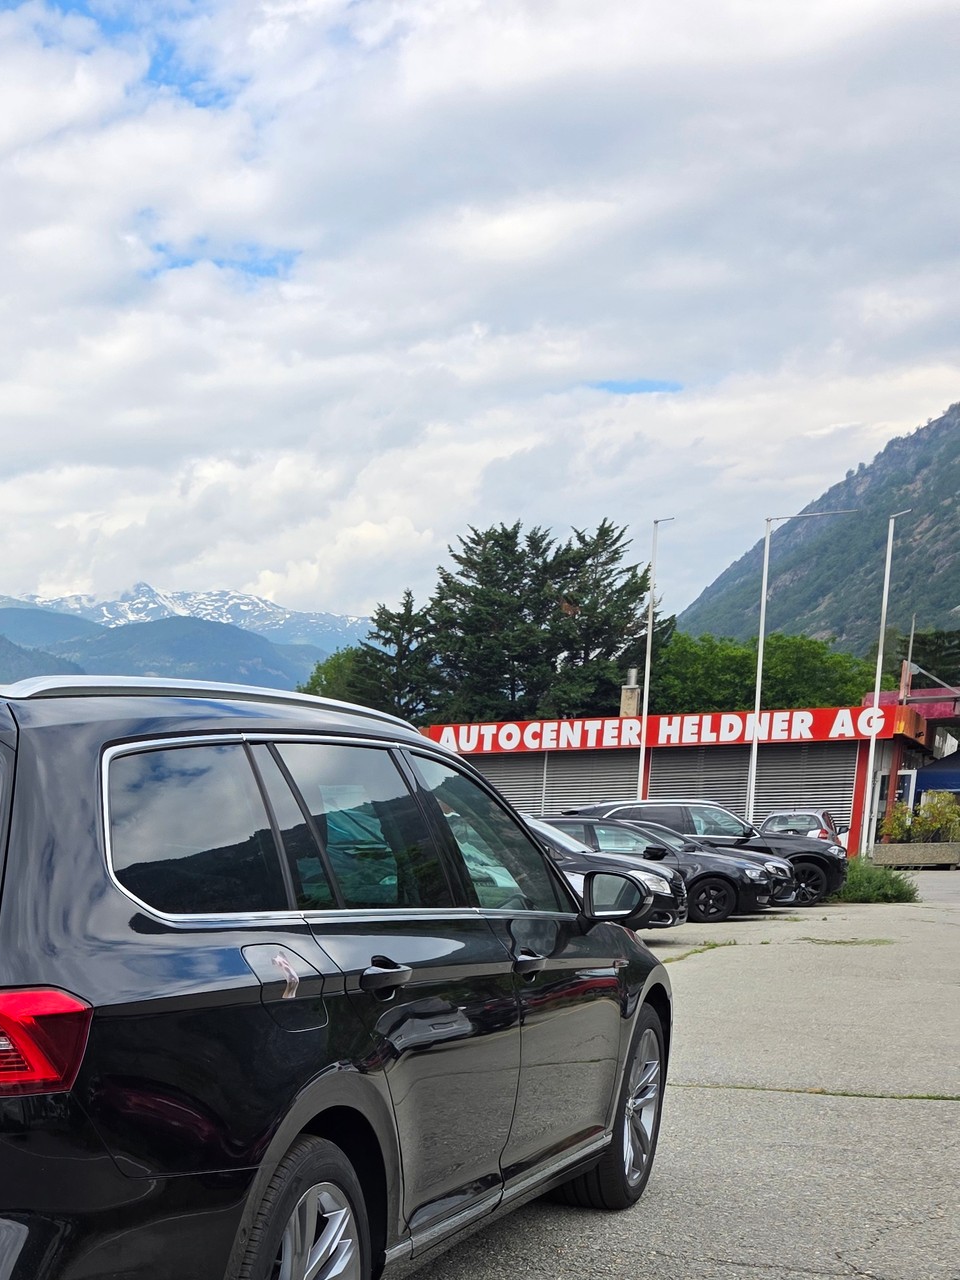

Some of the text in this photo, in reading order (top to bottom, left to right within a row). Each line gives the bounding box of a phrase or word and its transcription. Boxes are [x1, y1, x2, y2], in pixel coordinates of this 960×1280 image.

[439, 706, 885, 752] AUTOCENTER HELDNER AG
